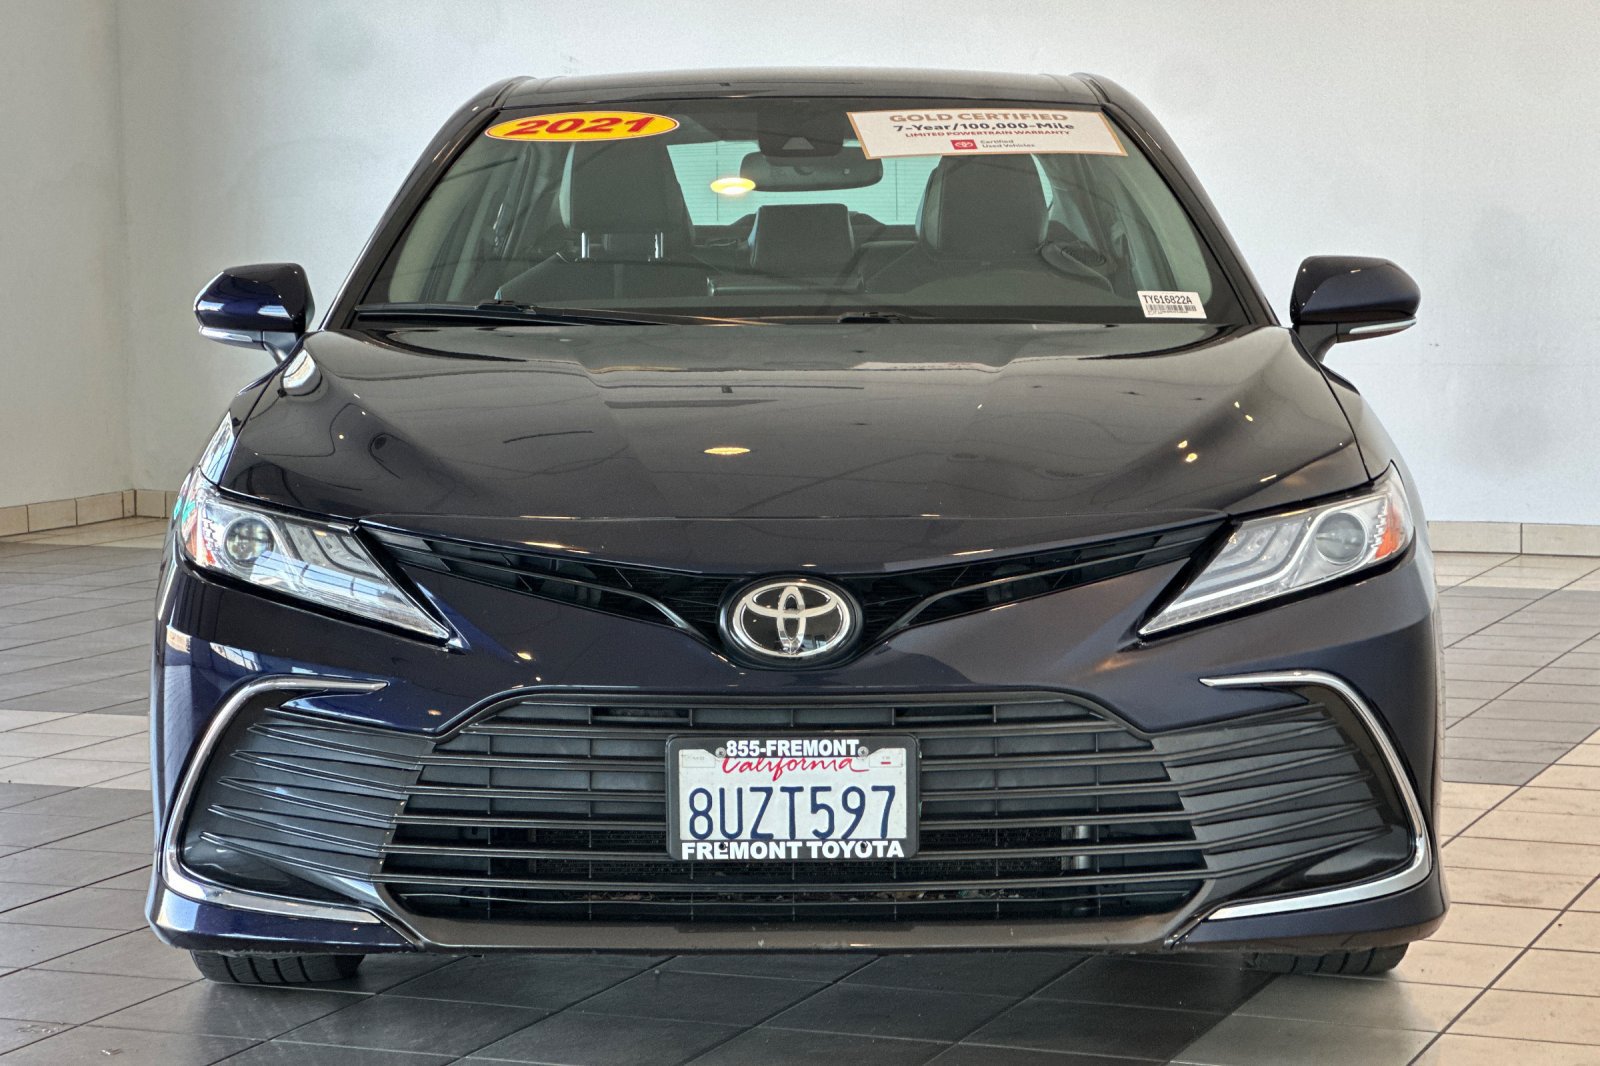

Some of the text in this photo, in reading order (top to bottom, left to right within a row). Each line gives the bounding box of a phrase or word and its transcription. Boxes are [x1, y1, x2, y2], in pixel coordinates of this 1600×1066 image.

[889, 112, 1068, 122] GOLD CERTIFIED
[503, 117, 655, 136] 2021
[893, 122, 1075, 132] 7-Year/100,000-Mile
[1142, 295, 1193, 304] TY616822A
[726, 739, 860, 757] 855-FREMONT
[722, 756, 869, 781] California
[689, 785, 896, 840] 8UZT597
[681, 840, 905, 860] FREMONT TOYOTA
